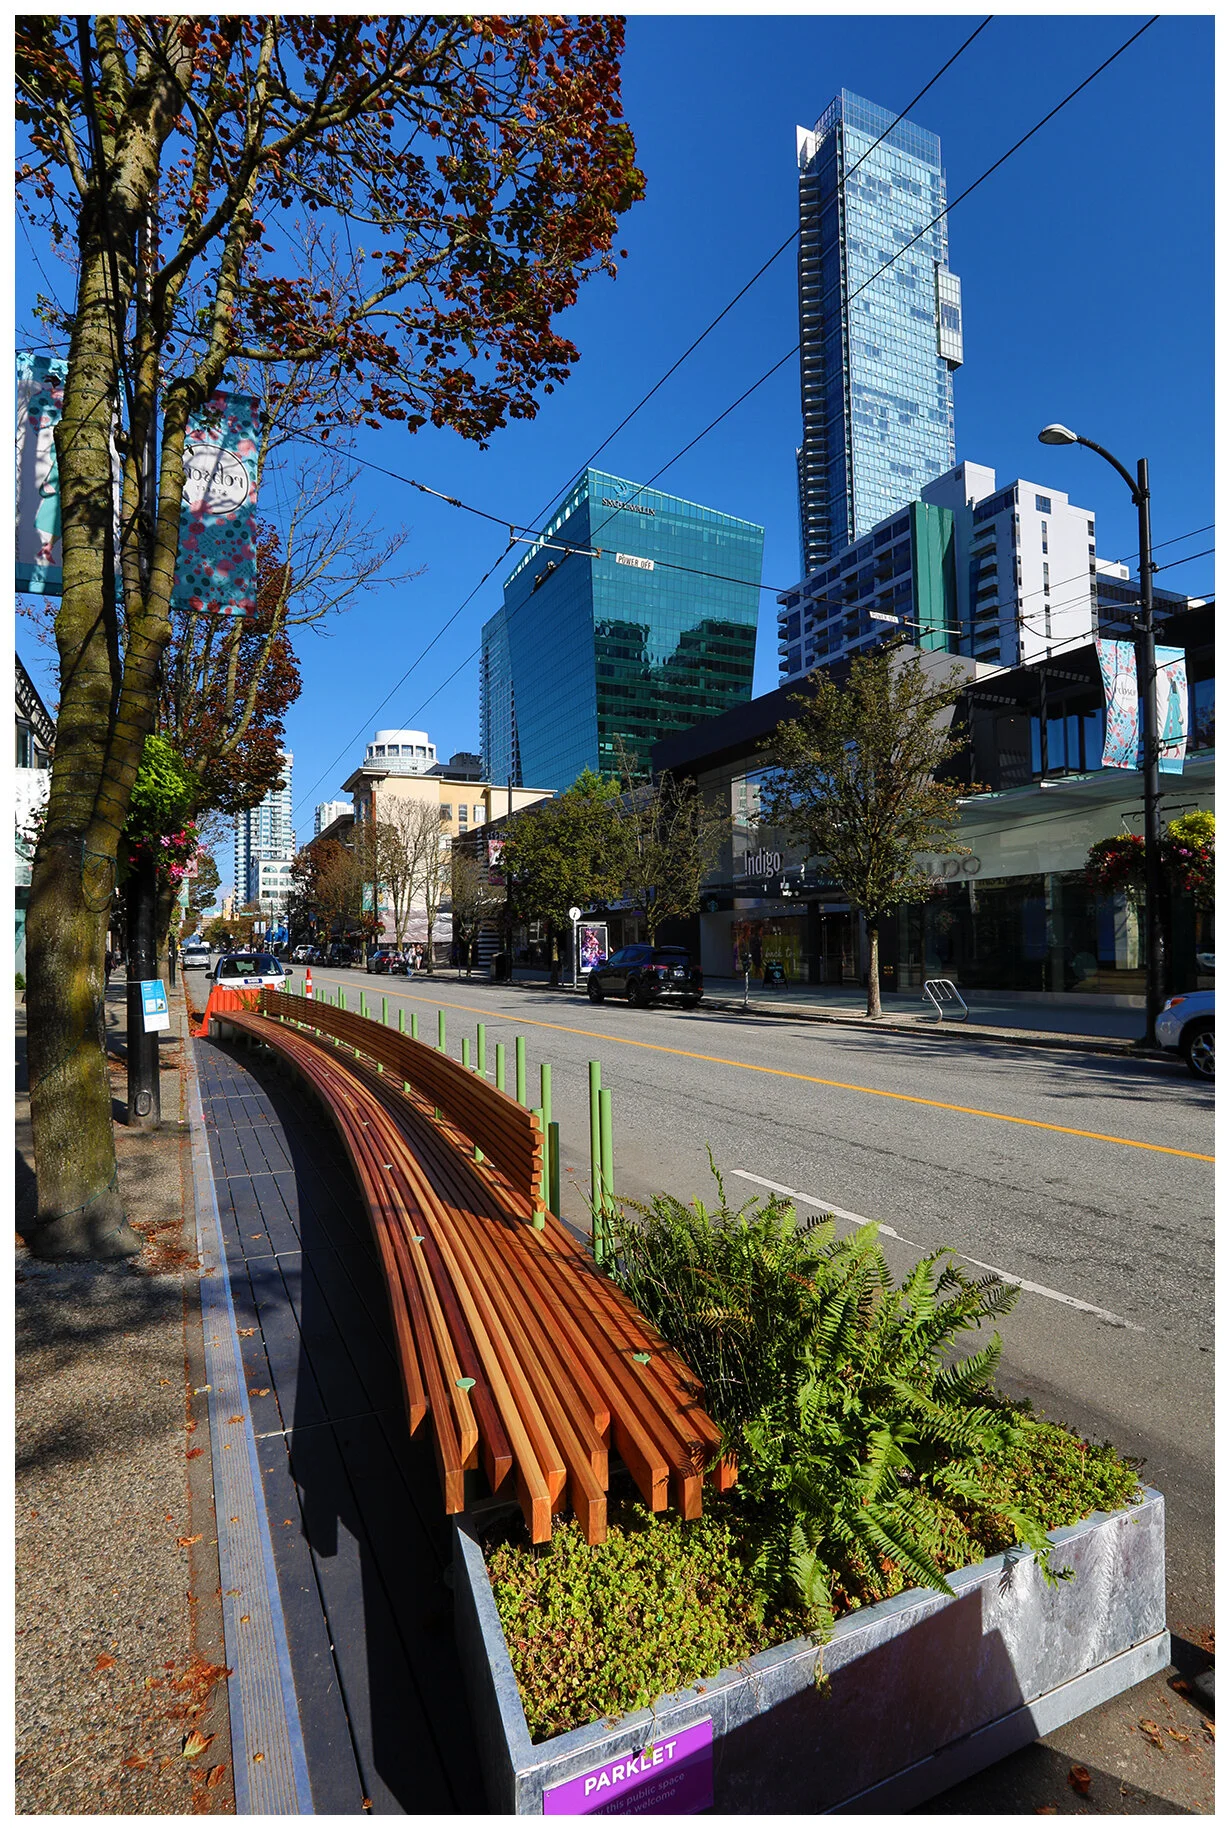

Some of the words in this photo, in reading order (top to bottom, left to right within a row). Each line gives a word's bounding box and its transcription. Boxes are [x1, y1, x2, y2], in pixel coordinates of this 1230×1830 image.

[618, 555, 639, 567] POWER
[640, 560, 652, 569] OFF
[744, 847, 781, 878] Indigo
[584, 1741, 677, 1796] PARKLET
[606, 1801, 624, 1814] this
[626, 1787, 656, 1806] public
[658, 1772, 685, 1791] space
[634, 1788, 676, 1813] welcome
